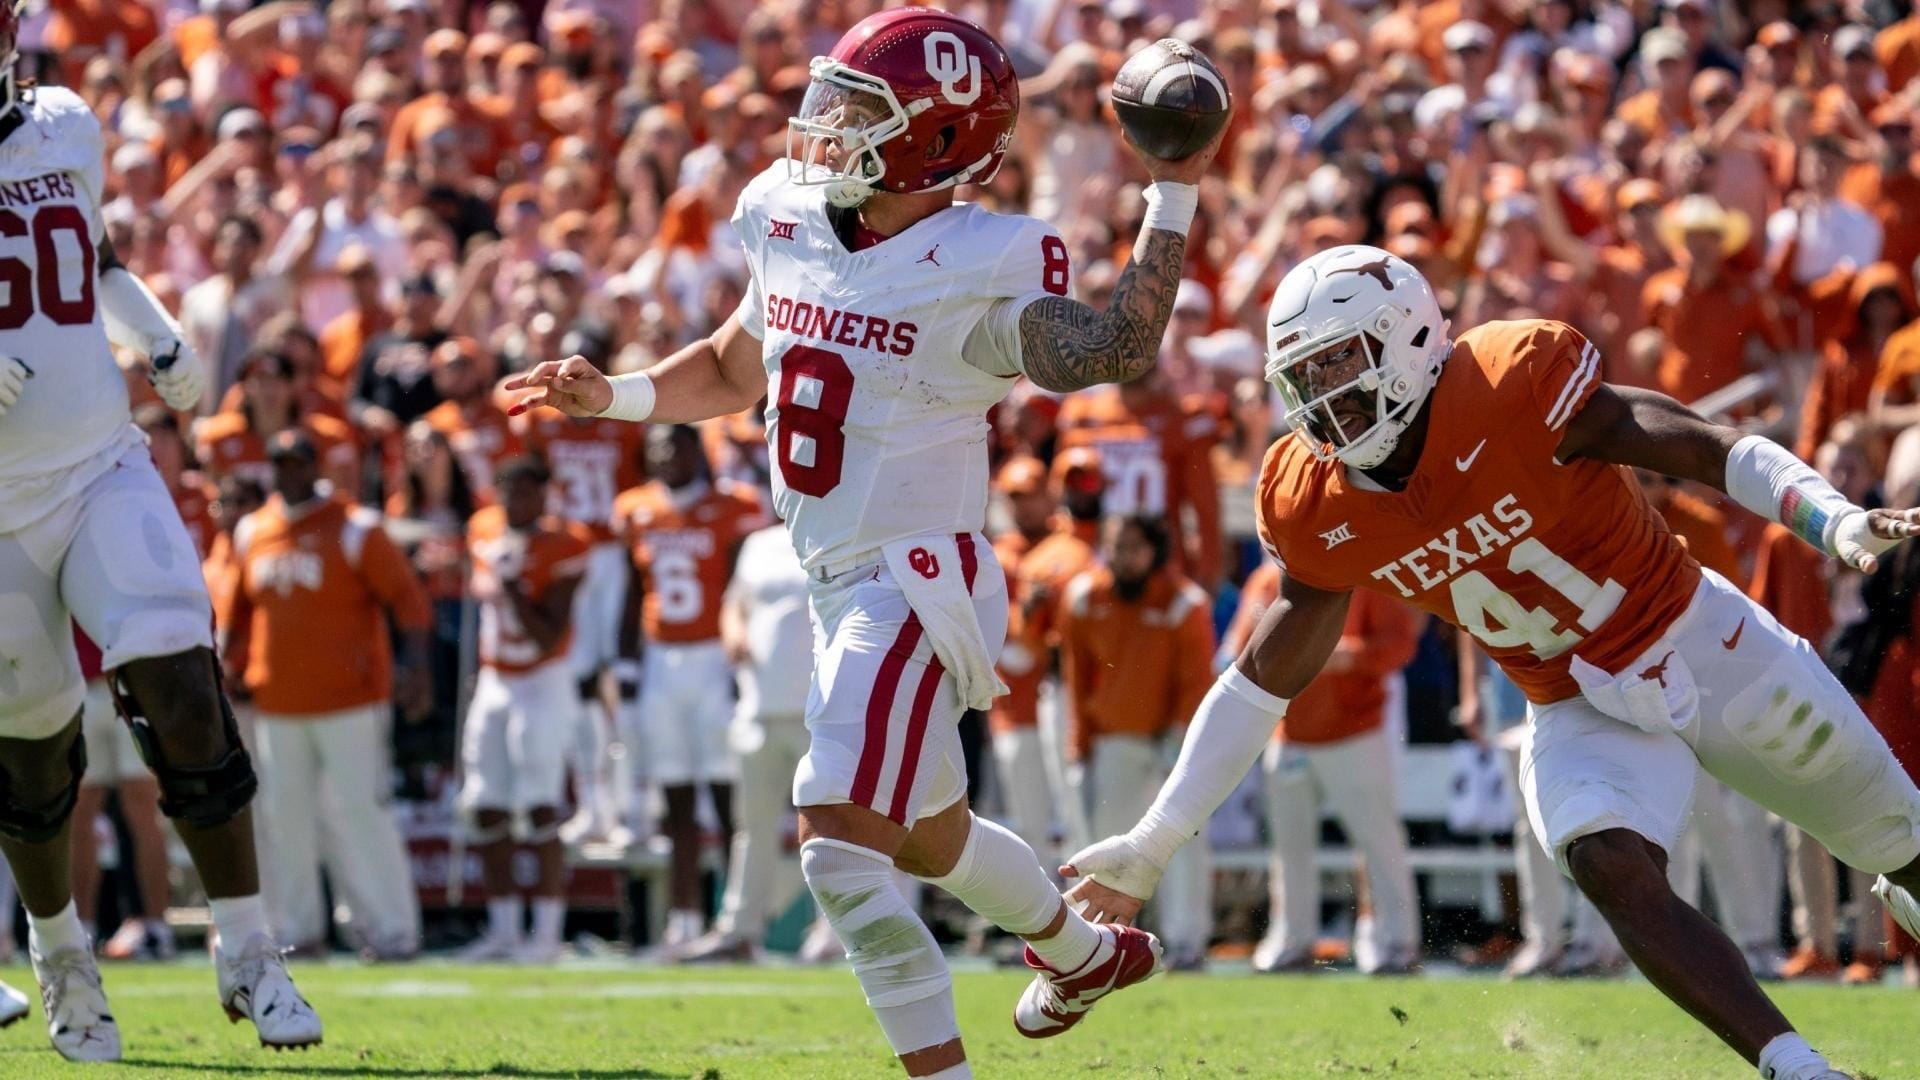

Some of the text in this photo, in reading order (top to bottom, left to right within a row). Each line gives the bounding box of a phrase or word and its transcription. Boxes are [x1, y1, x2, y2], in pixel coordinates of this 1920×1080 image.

[923, 31, 981, 106] OU
[0, 172, 75, 207] NERS
[0, 204, 96, 330] 60
[1041, 234, 1069, 297] 8
[766, 293, 918, 357] SOONERS
[777, 343, 855, 498] 8
[908, 547, 940, 579] OU
[1370, 493, 1533, 598] TEXAS
[653, 553, 704, 624] 6
[1449, 536, 1628, 661] 41
